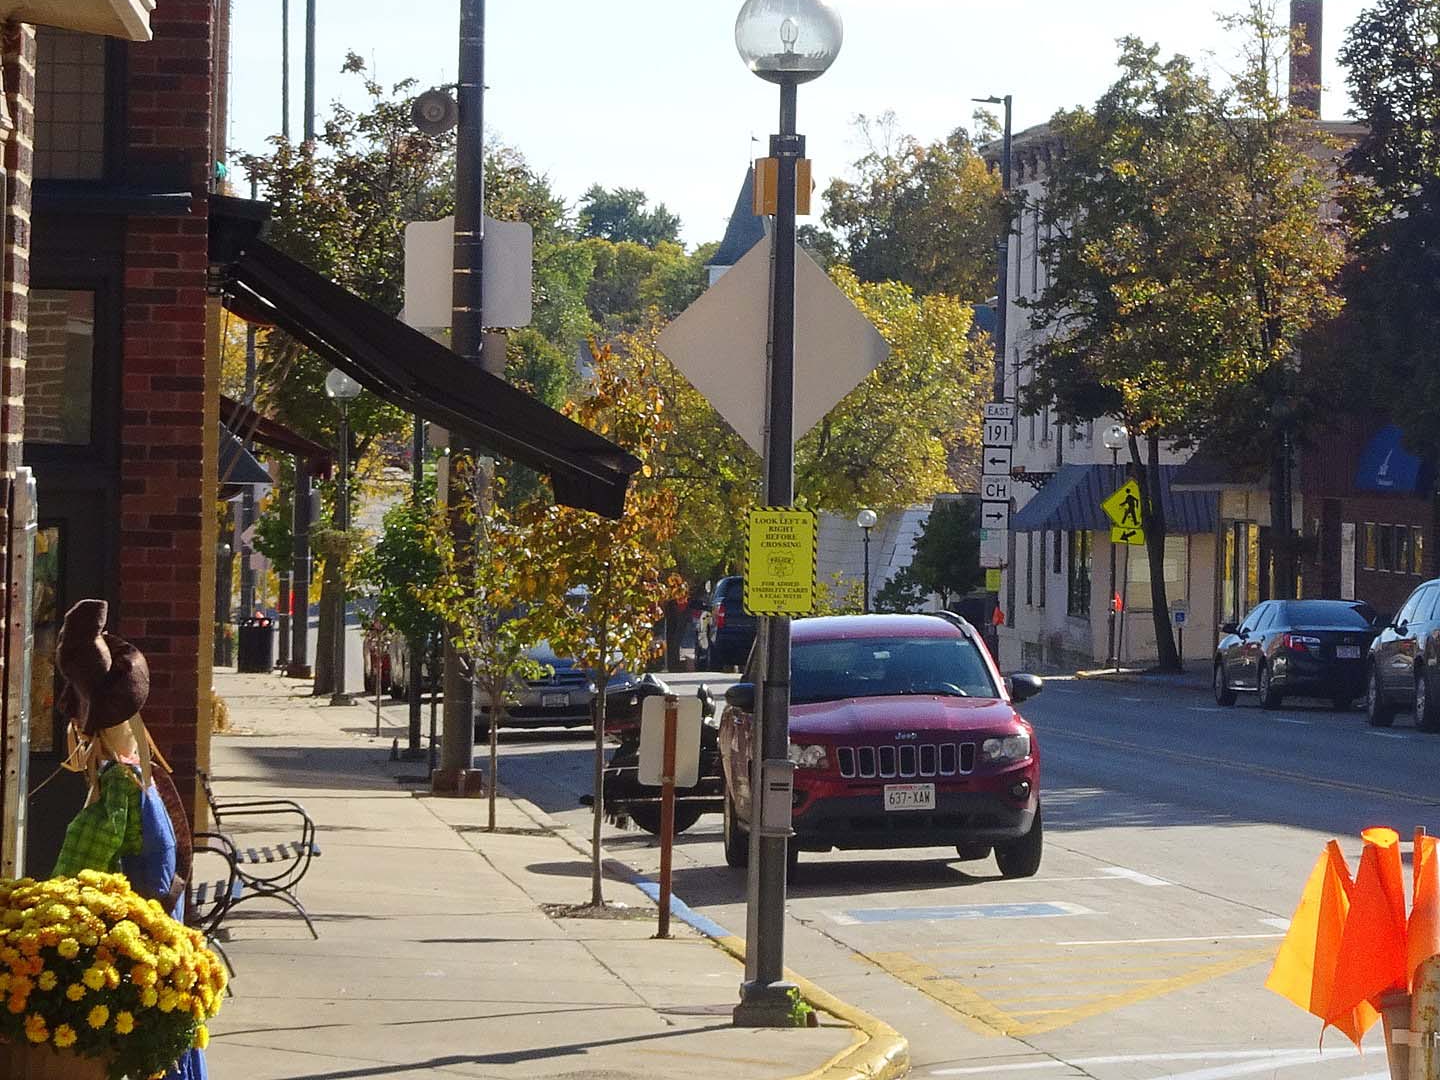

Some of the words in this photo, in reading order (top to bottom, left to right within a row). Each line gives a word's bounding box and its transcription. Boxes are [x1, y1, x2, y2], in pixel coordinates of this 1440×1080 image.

[988, 405, 1009, 416] EAST
[988, 425, 1008, 441] 191
[986, 483, 1006, 497] CH
[754, 517, 778, 525] LOOK
[779, 517, 799, 525] LEFT
[765, 533, 796, 541] BEFORE
[895, 732, 917, 740] Jeep
